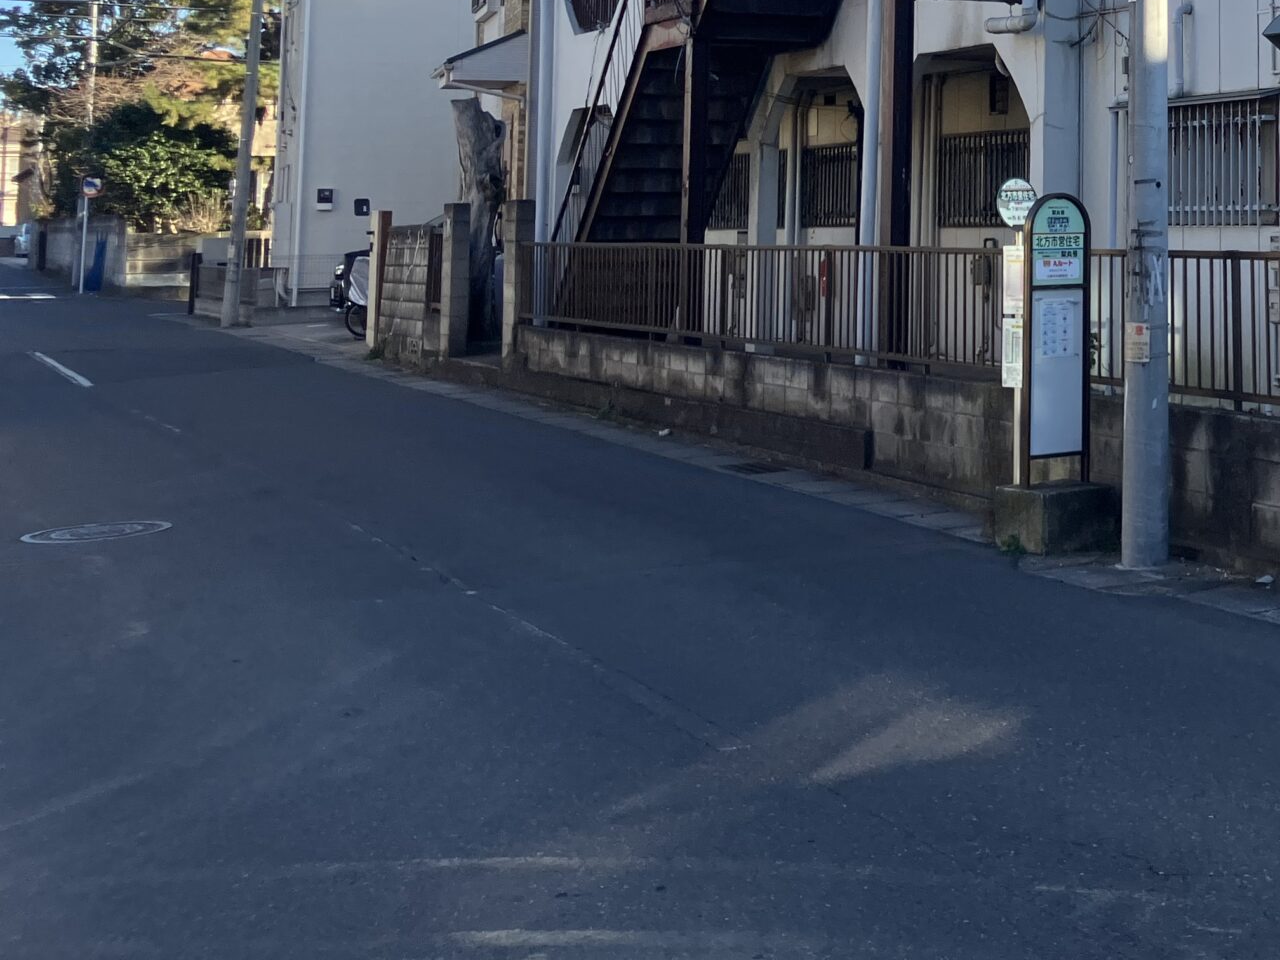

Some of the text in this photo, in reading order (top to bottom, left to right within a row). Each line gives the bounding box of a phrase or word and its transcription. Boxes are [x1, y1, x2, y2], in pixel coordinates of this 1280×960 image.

[1036, 235, 1080, 248] 北方市営住宅
